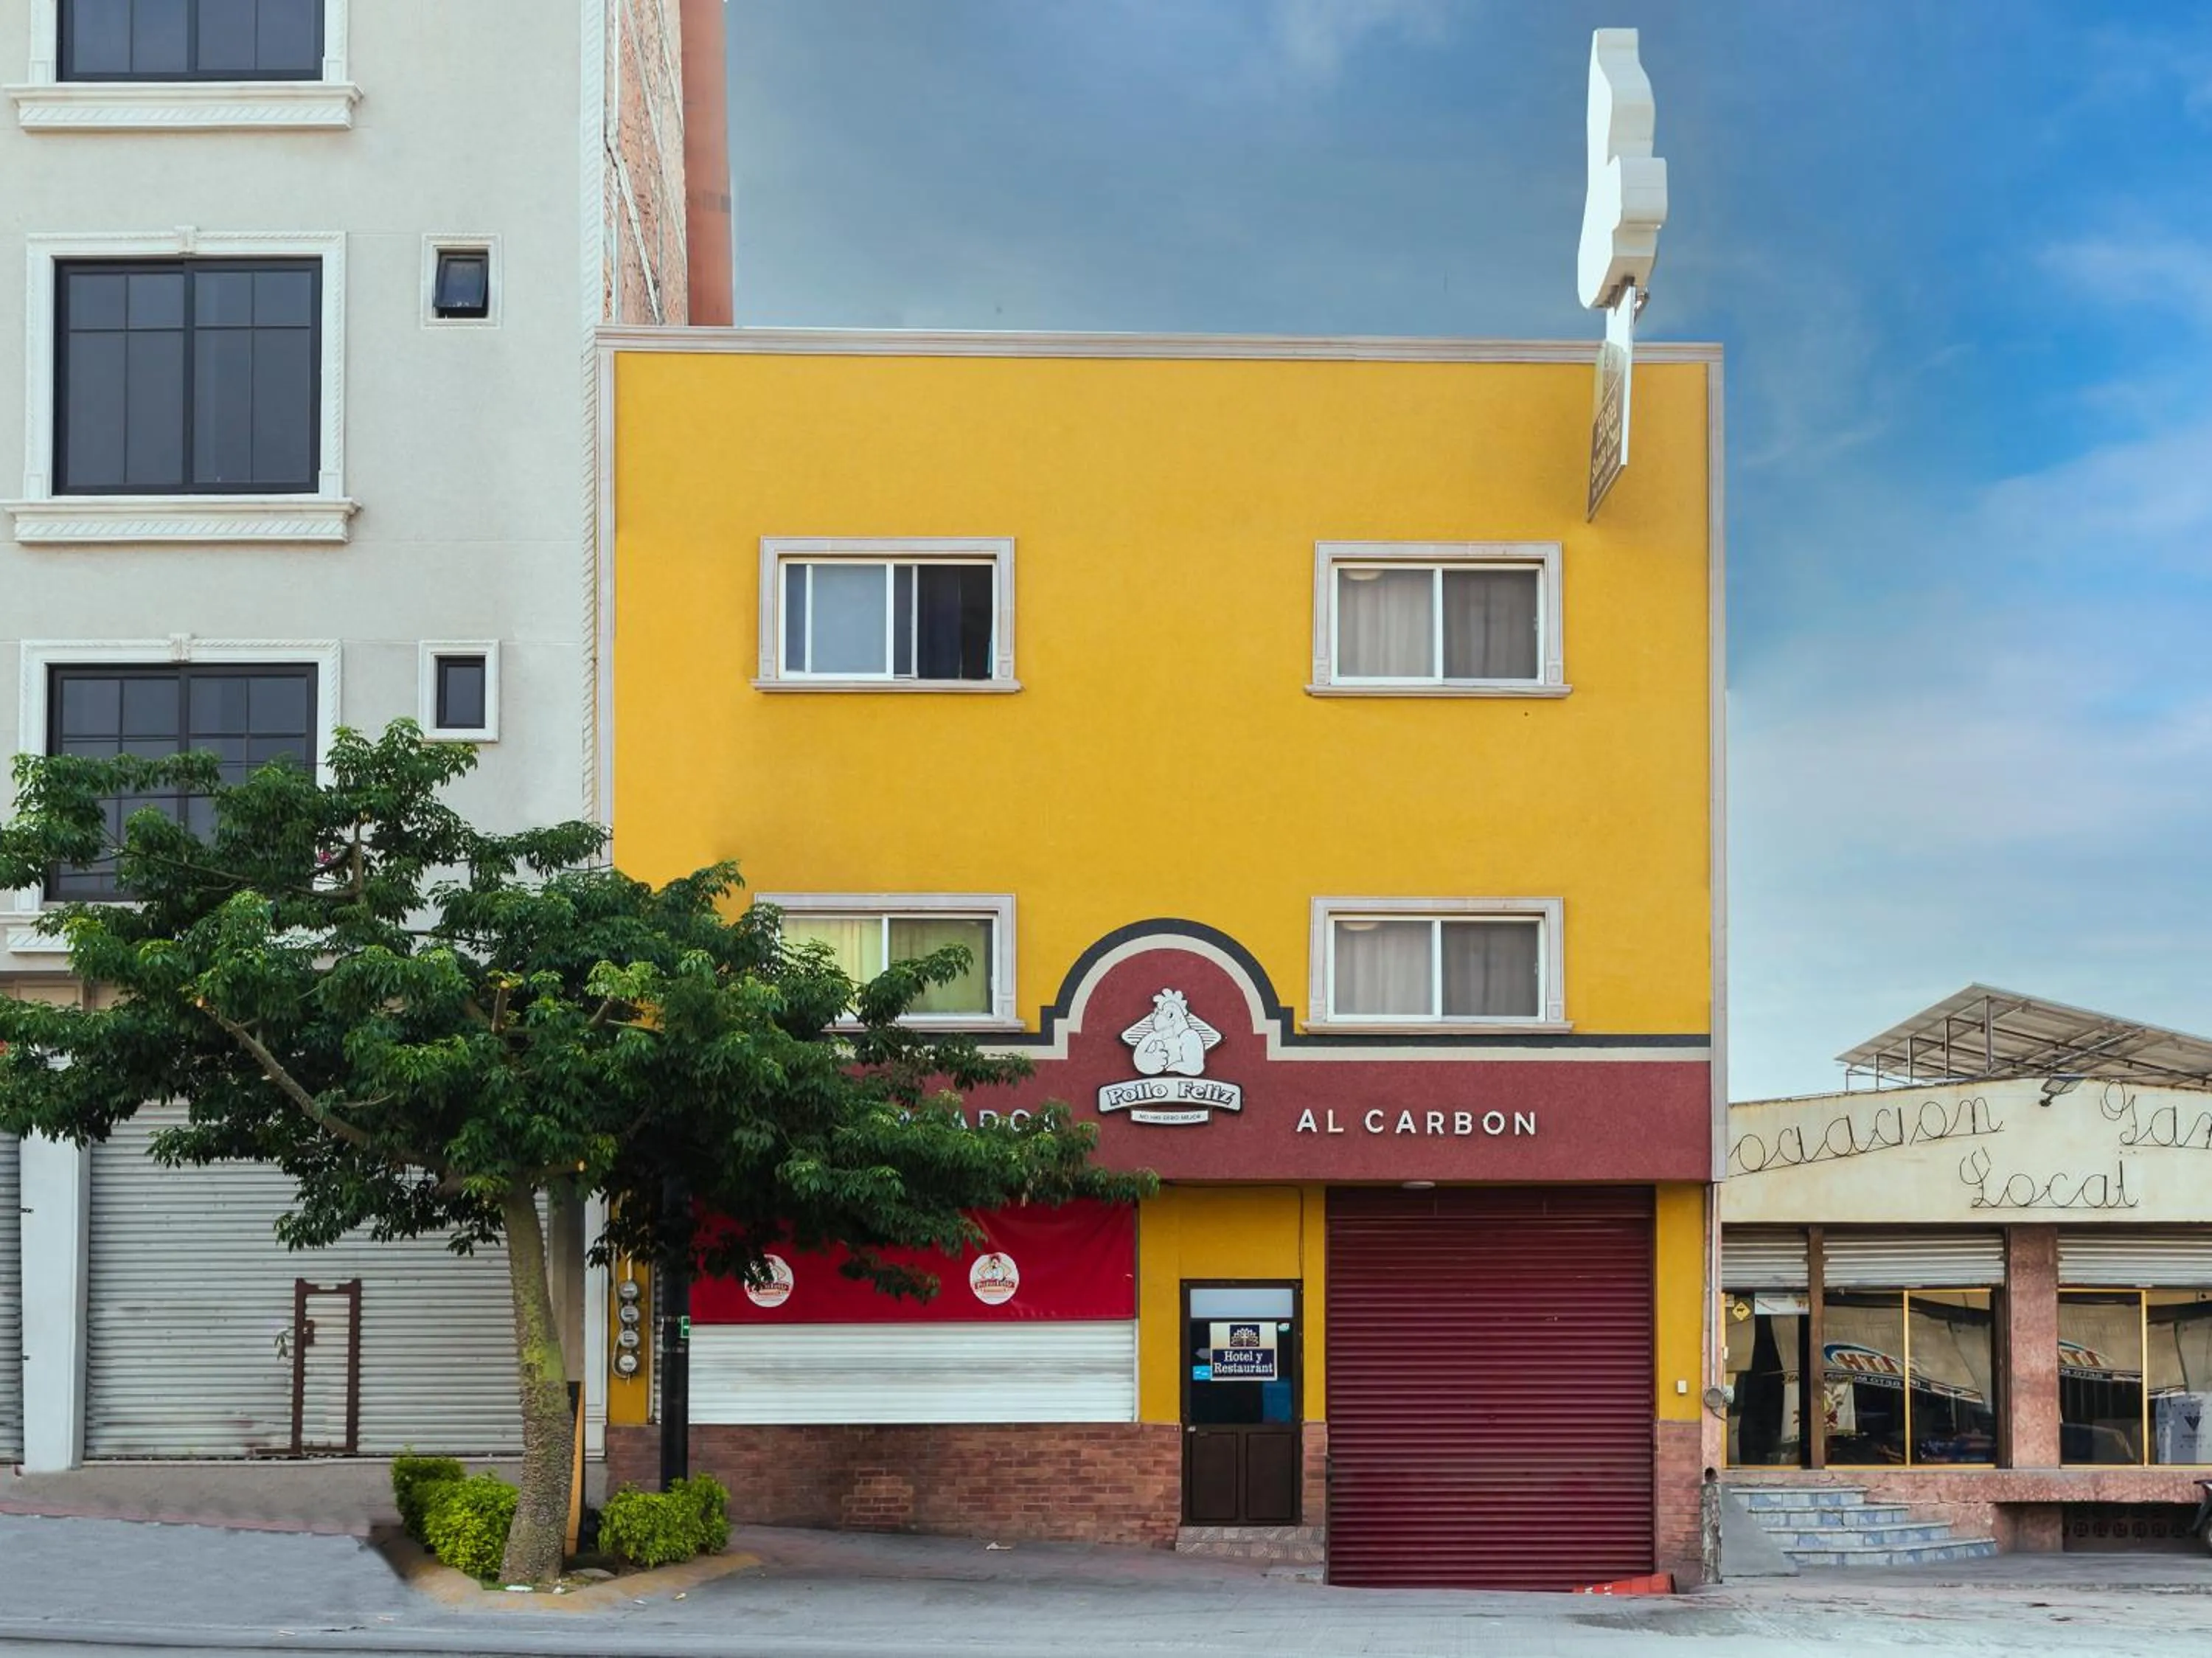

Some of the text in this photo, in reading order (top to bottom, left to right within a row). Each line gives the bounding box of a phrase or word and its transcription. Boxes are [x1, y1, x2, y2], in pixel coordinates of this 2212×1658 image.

[1107, 1081, 1236, 1106] Pollo Feliz
[1296, 1109, 1344, 1133] AL
[1365, 1109, 1537, 1136] CARBON
[1958, 1146, 2139, 1208] Local
[1214, 1362, 1273, 1373] Restaurant
[1224, 1350, 1263, 1364] Hotel y
